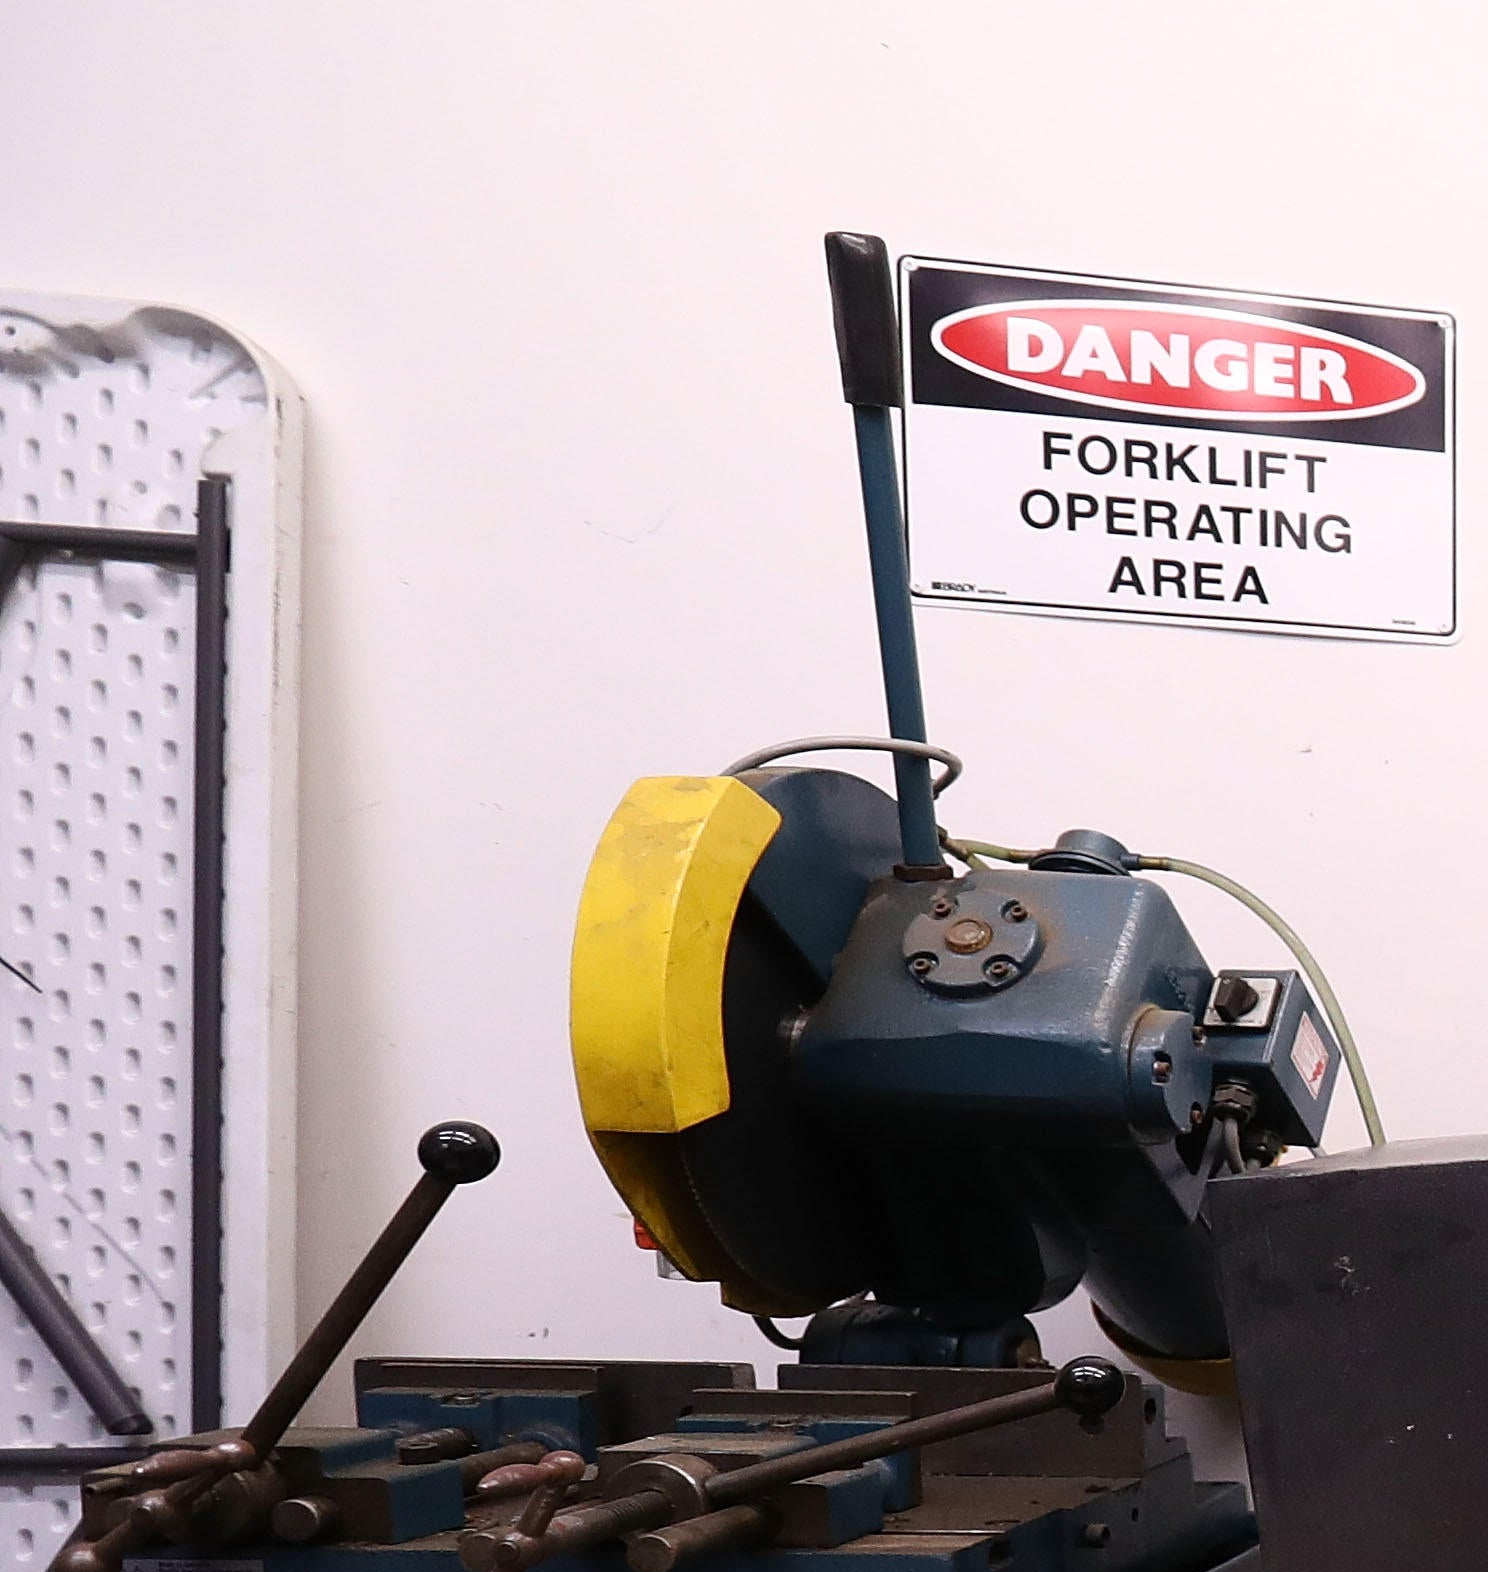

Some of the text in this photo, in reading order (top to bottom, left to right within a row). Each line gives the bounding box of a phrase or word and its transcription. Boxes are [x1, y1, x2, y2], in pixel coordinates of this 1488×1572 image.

[1006, 317, 1353, 404] DANGER
[1042, 430, 1327, 493] FORKLIFT
[1019, 488, 1353, 553] OPERATING
[1107, 556, 1270, 605] AREA
